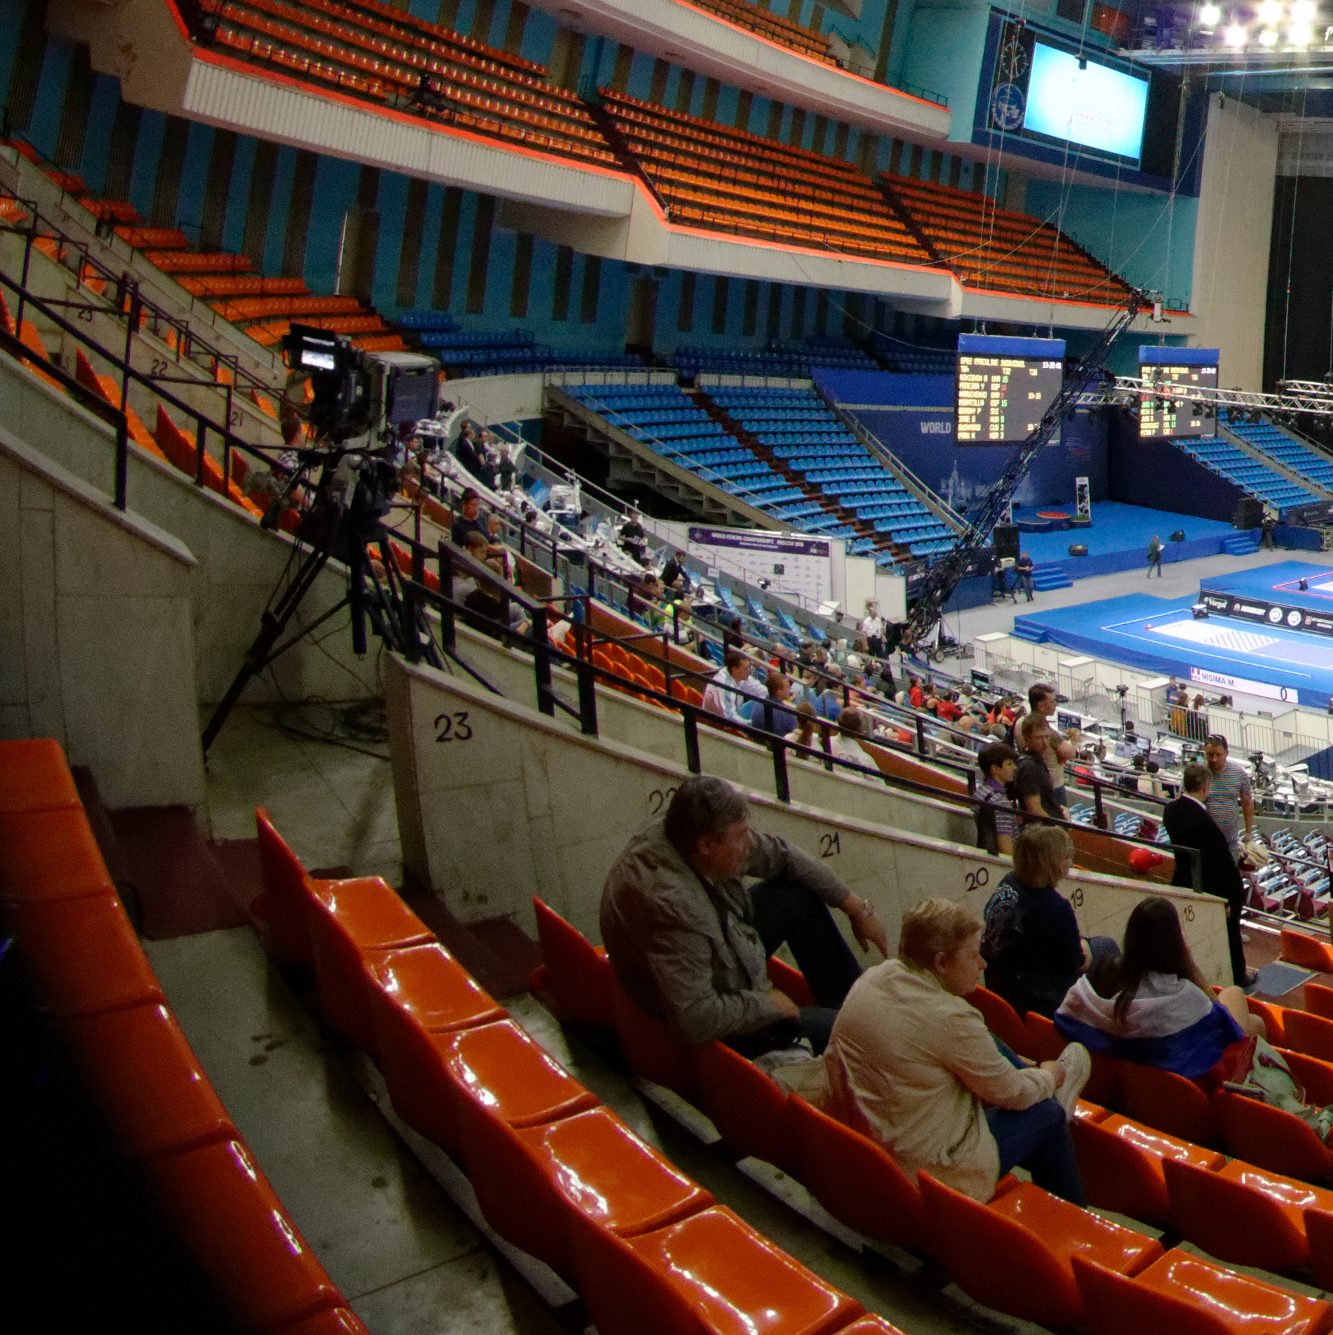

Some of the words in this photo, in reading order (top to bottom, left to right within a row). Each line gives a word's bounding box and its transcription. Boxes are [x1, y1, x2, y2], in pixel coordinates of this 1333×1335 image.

[152, 360, 168, 376] 22
[1001, 399, 1008, 407] 15
[921, 421, 951, 434] WORLD
[1201, 673, 1227, 685] NISIMA
[1228, 678, 1236, 687] M.
[1280, 687, 1288, 701] 0
[434, 711, 472, 742] 23
[820, 832, 840, 858] 21
[965, 867, 989, 892] 20
[1070, 888, 1084, 910] 19
[1183, 905, 1195, 923] 18
